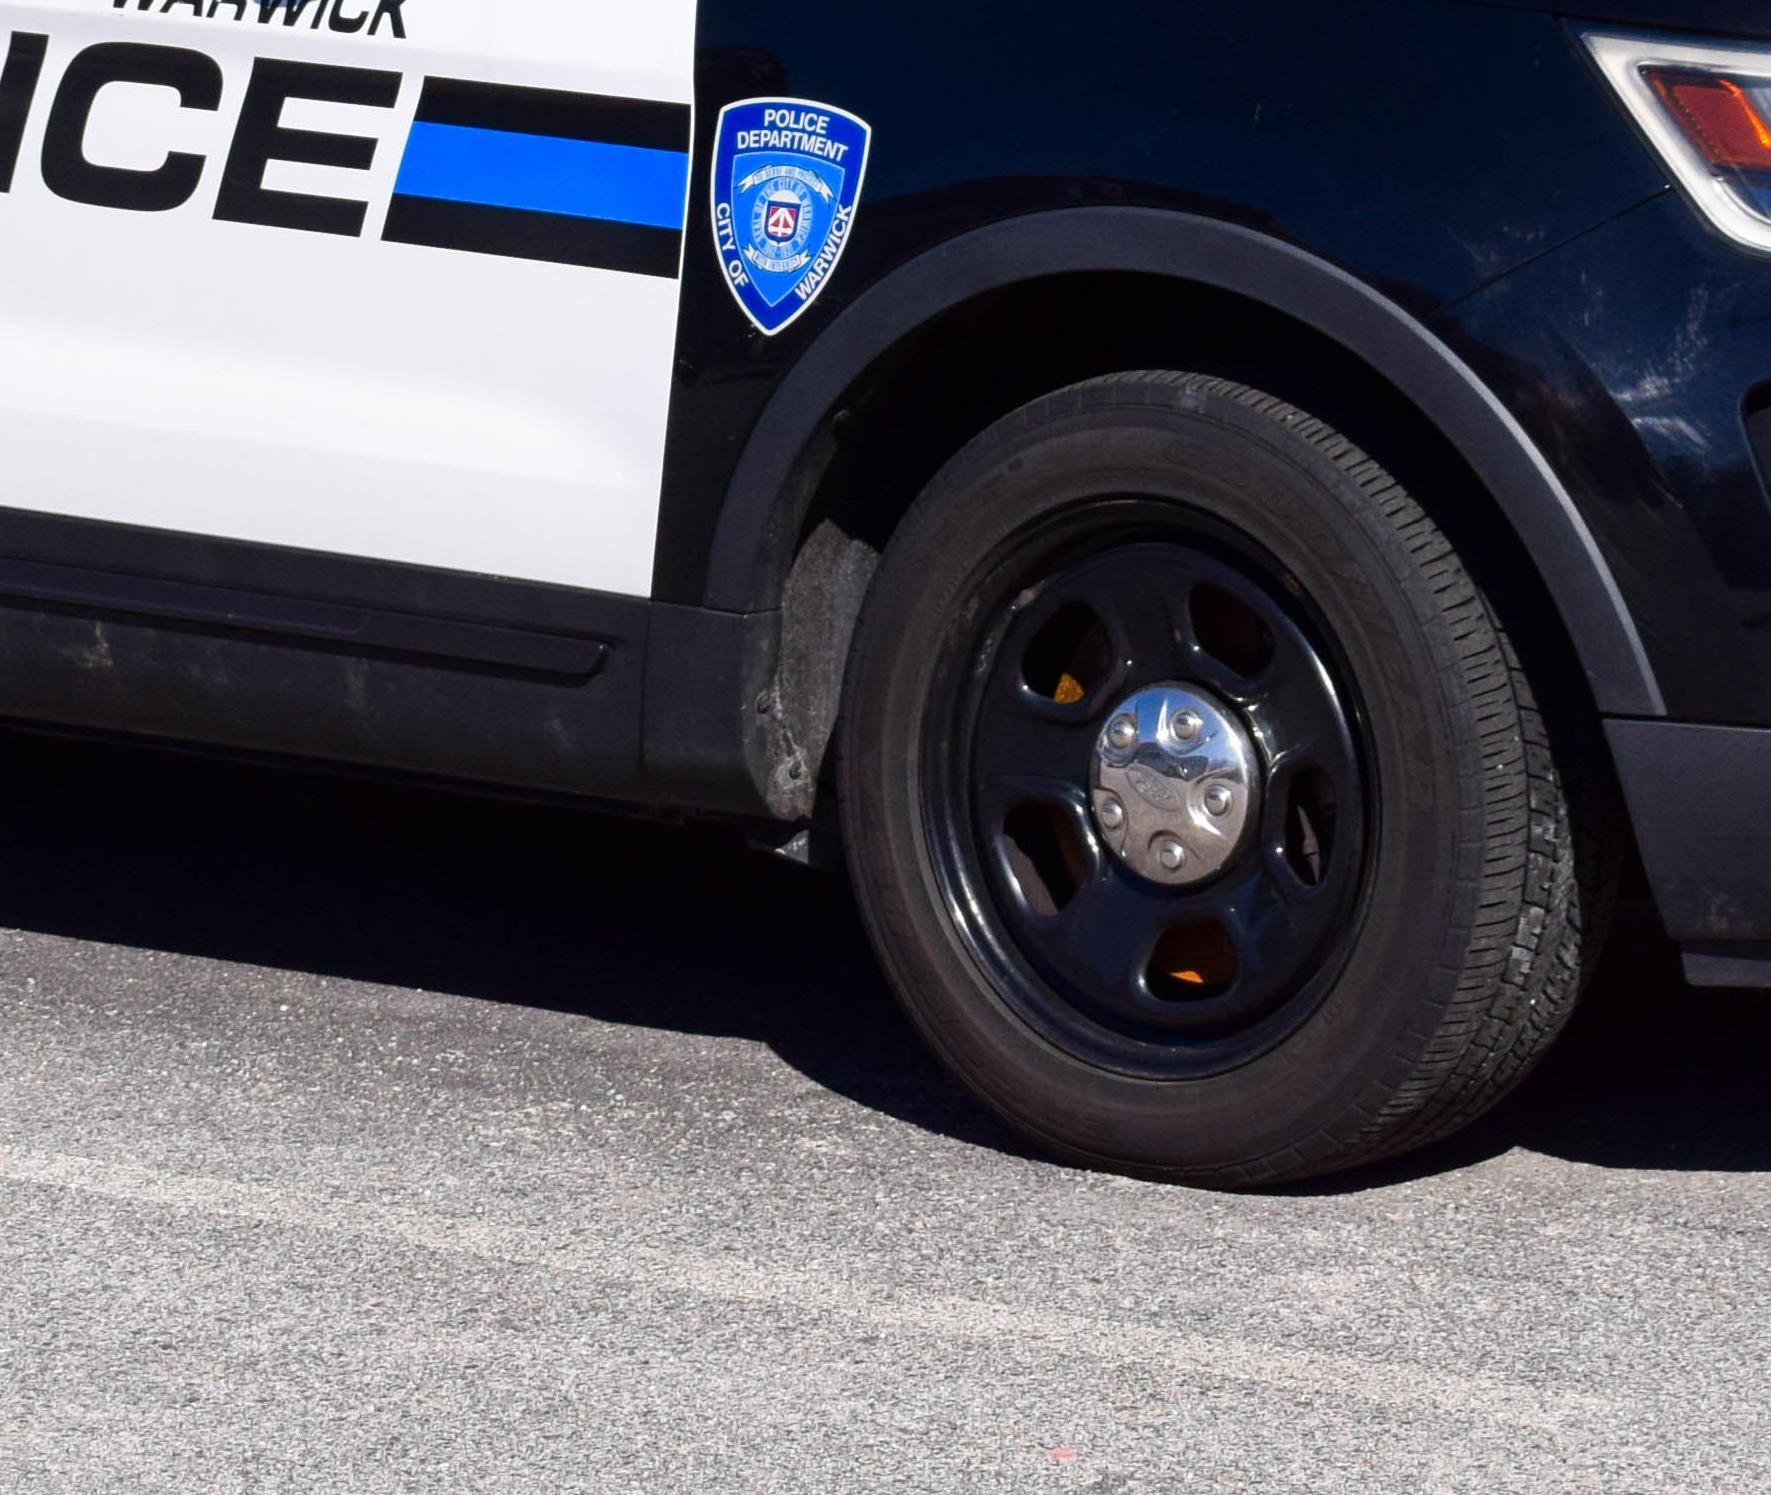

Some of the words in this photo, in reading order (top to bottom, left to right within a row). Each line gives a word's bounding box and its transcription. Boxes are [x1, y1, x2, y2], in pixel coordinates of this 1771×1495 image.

[764, 109, 829, 134] POLICE
[737, 130, 848, 162] DEPARTMENT
[717, 202, 736, 251] CITY
[729, 259, 749, 287] OF
[794, 204, 852, 302] WARWICK
